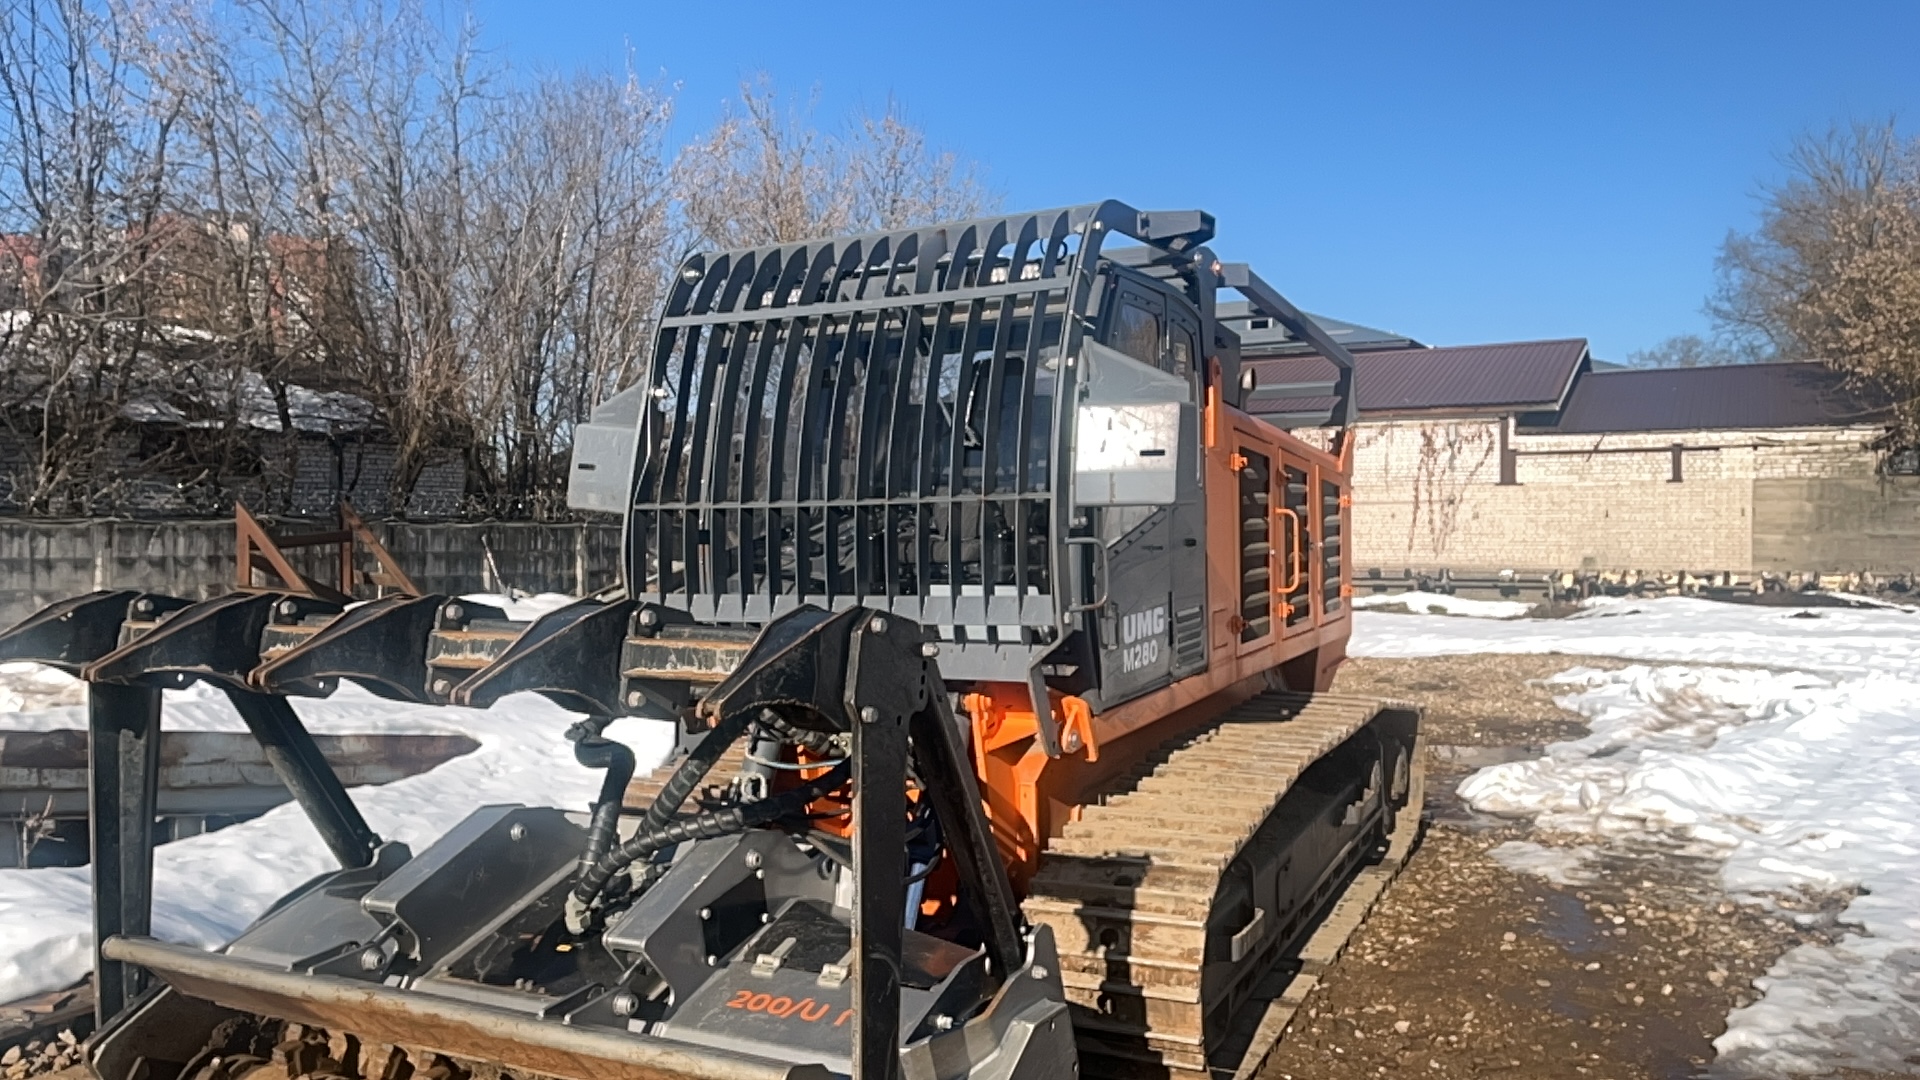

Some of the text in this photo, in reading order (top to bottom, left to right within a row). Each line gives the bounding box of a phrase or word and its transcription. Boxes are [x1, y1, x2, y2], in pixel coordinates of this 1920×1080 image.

[1123, 607, 1164, 644] UMG
[1123, 640, 1158, 673] M280
[726, 990, 829, 1021] 200/U
